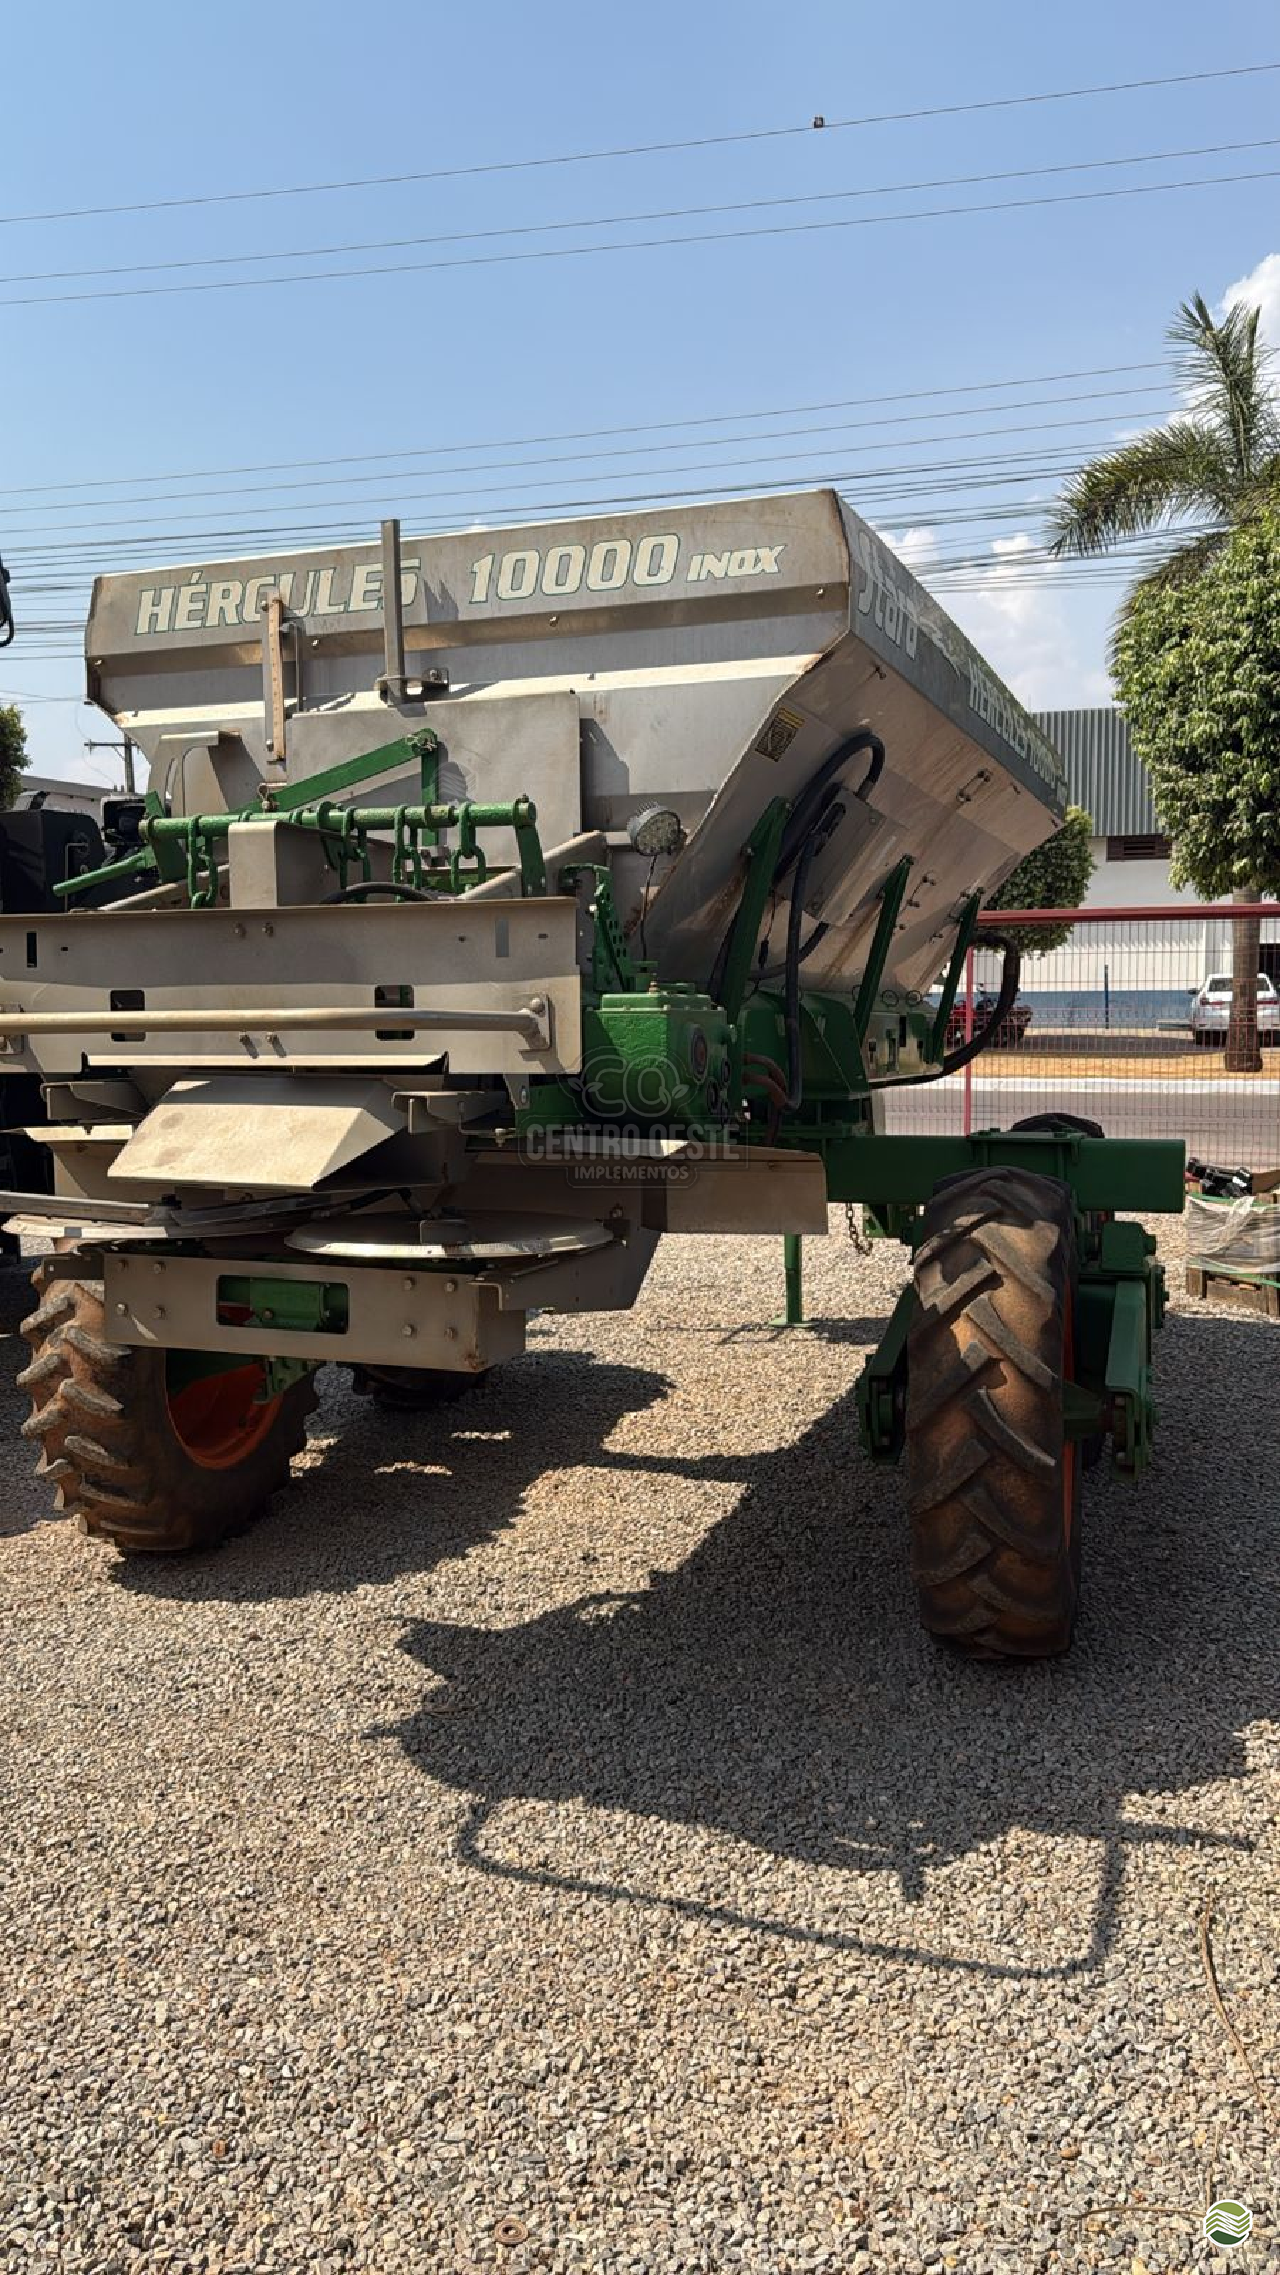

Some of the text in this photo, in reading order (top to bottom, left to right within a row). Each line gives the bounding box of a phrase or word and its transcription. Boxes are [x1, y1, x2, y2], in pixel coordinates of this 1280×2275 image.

[134, 533, 787, 636] HÉRCULES 10000 INOX
[857, 529, 919, 661] Stara
